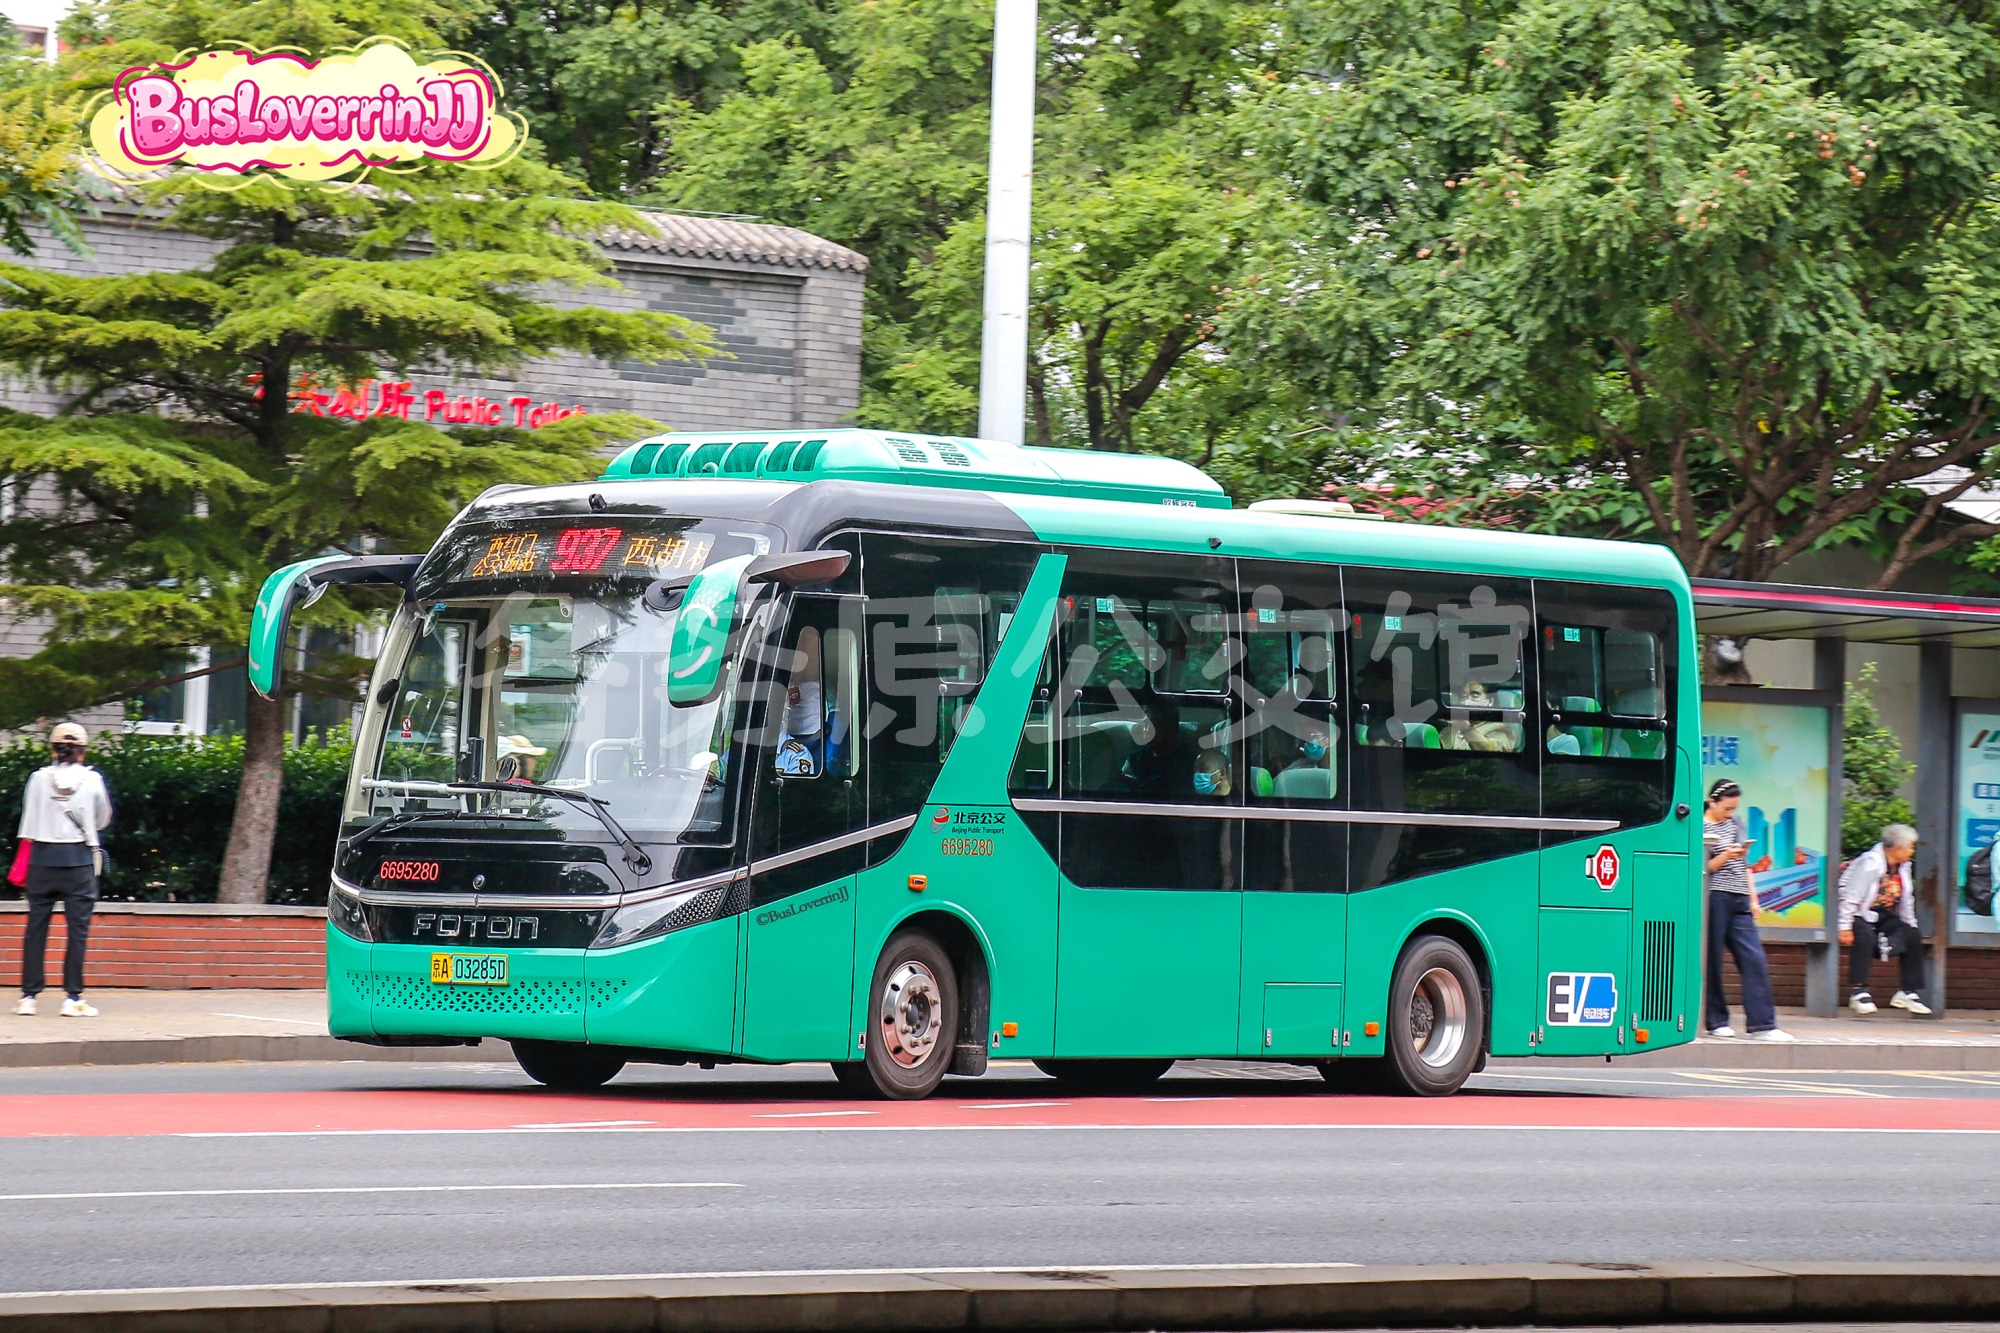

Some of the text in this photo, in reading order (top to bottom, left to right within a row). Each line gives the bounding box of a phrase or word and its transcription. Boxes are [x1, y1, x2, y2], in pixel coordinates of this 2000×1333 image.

[423, 390, 502, 426] Public
[486, 533, 539, 558] 西红门
[551, 529, 622, 570] 937
[472, 550, 538, 577] 公交场站
[951, 826, 967, 835] Beijing
[982, 827, 1005, 835] Transport
[953, 812, 1006, 825] 北京公交
[941, 838, 994, 856] 6695280
[380, 861, 439, 881] 6695280
[1600, 856, 1615, 880] 停
[412, 913, 539, 940] FOTON
